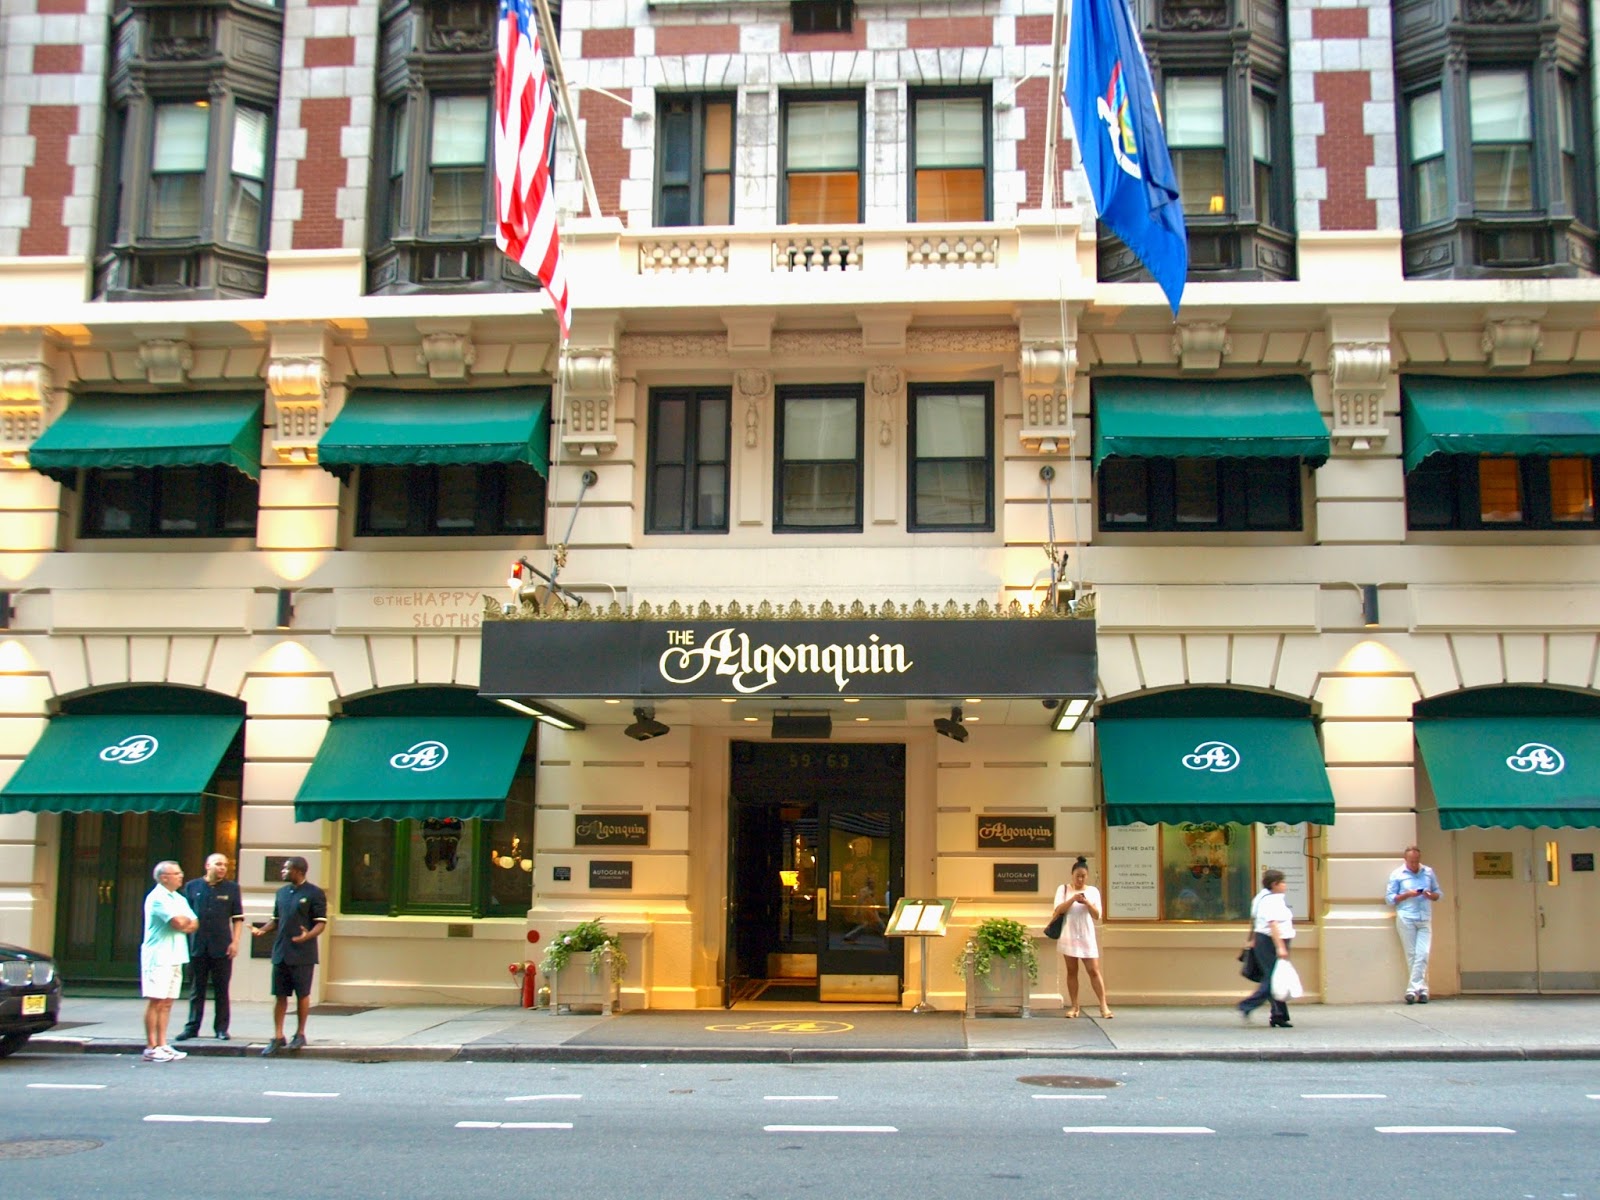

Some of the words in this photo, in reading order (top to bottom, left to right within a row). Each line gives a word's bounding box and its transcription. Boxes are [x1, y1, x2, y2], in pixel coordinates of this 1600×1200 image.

[667, 630, 694, 645] THE
[659, 628, 913, 694] Algonquin
[576, 820, 647, 840] Algonquin
[979, 822, 1053, 842] Algonquin
